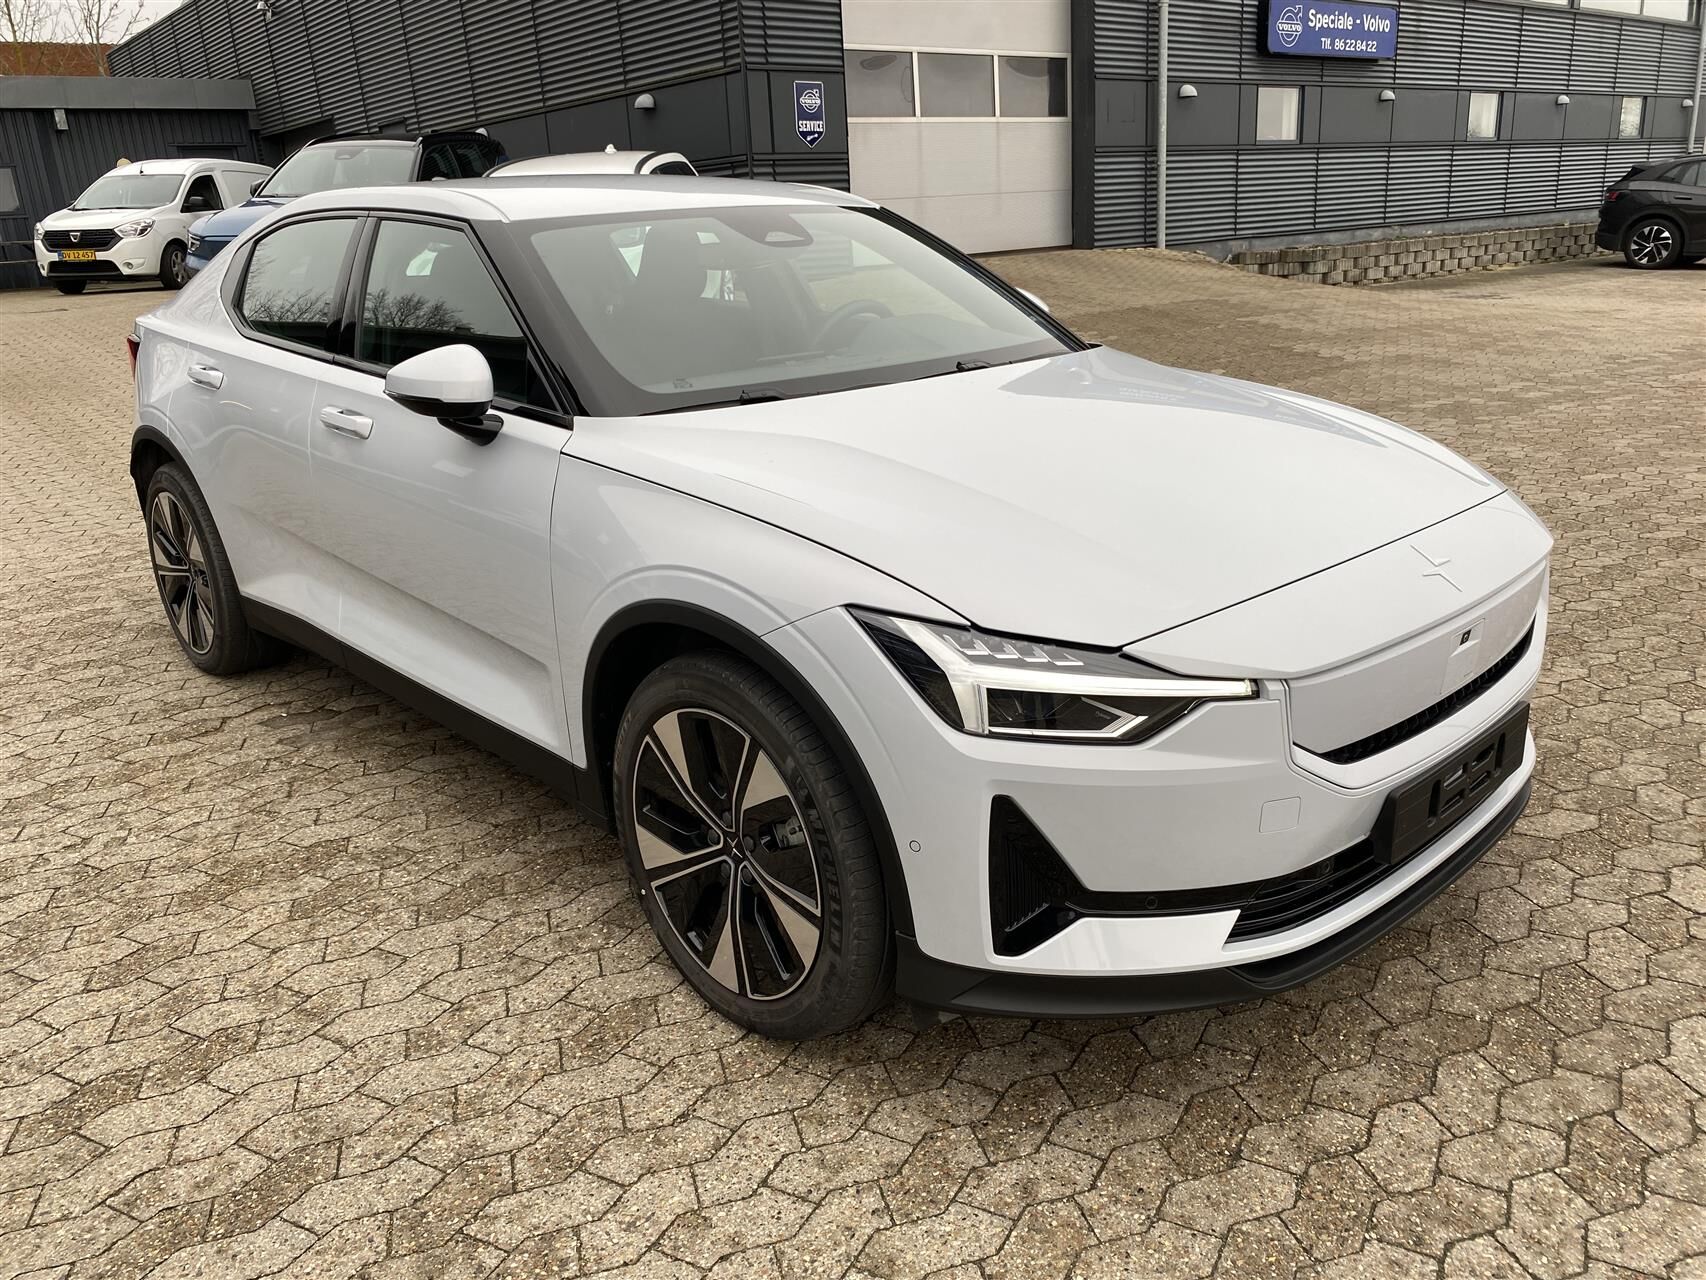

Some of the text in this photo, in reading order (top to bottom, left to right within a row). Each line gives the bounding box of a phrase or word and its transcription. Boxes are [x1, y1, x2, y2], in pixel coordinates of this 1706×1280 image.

[1308, 9, 1353, 31] Speciale
[1363, 14, 1390, 32] Volvo
[1278, 23, 1302, 32] VOLVO
[1320, 37, 1332, 50] Tlf.
[798, 120, 824, 132] SERVICE
[72, 251, 81, 259] 12
[81, 251, 94, 259] 457
[807, 807, 843, 955] MICHELIN
